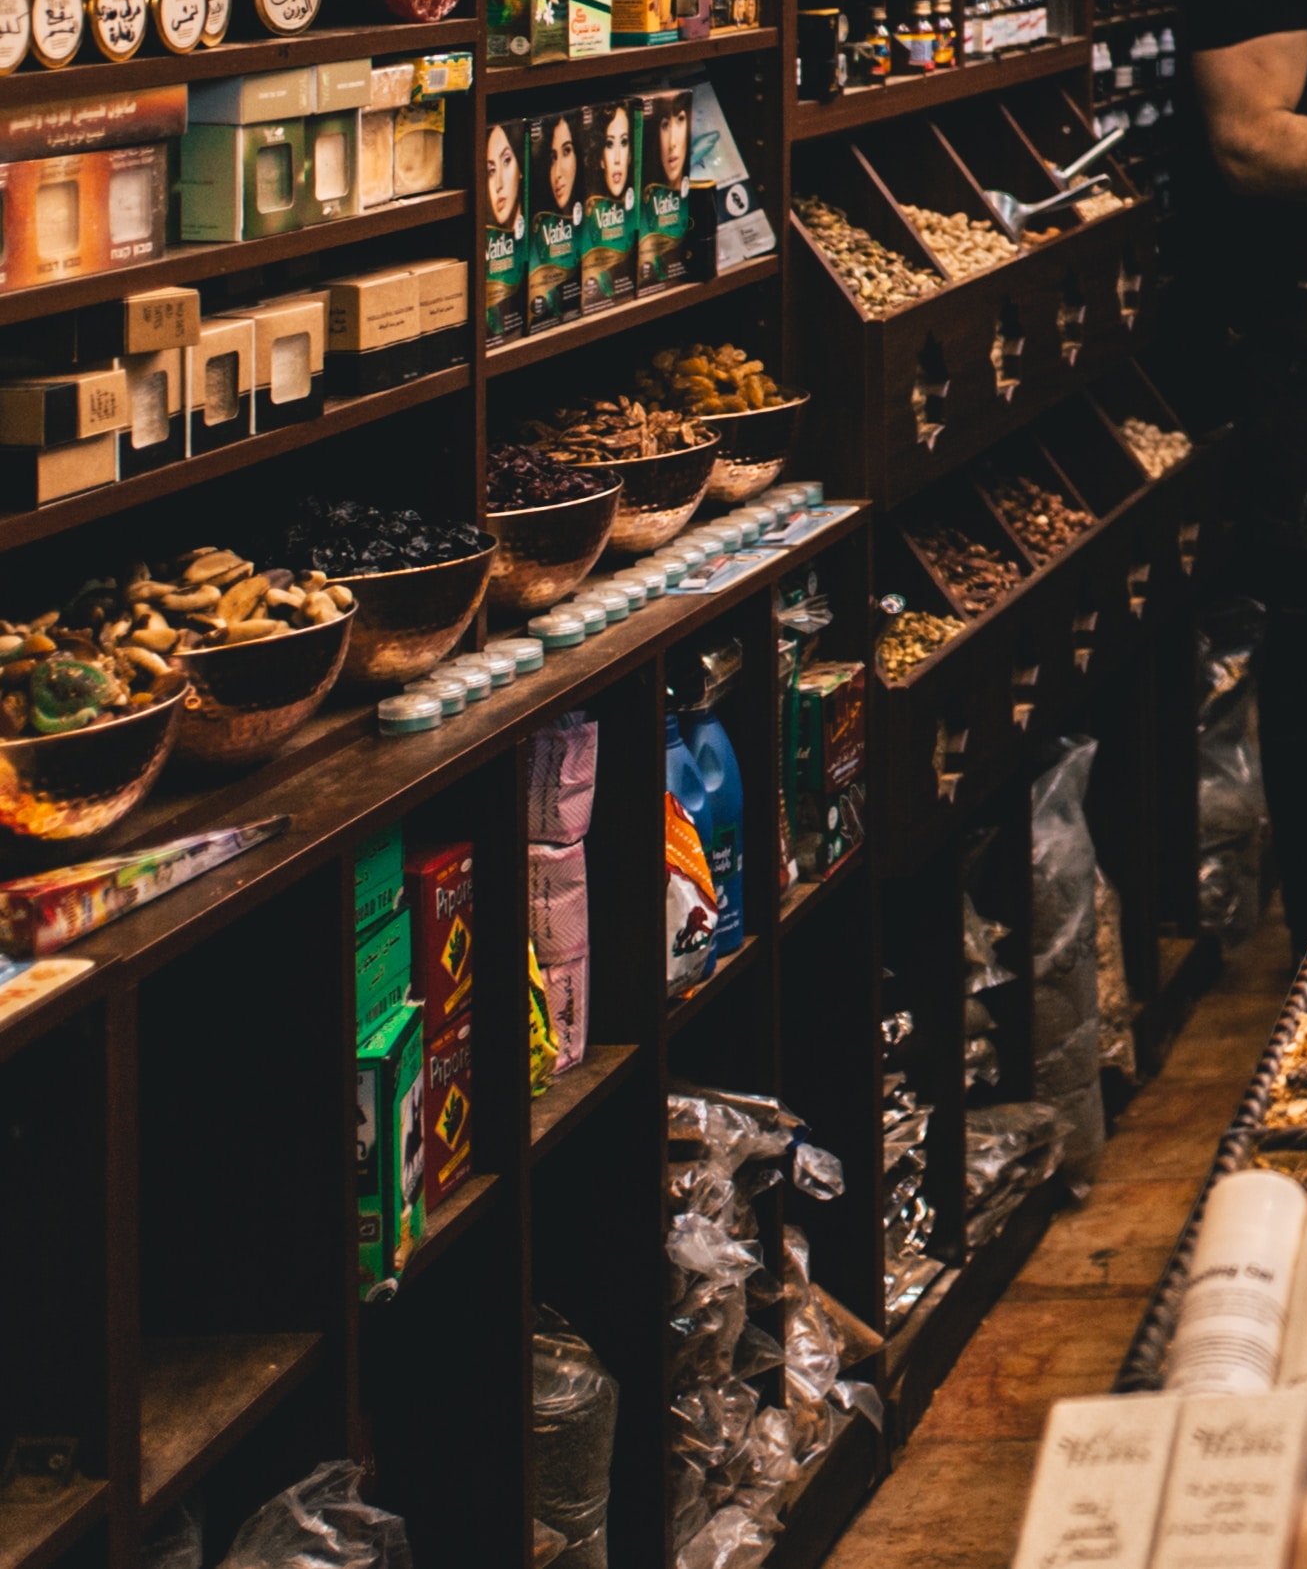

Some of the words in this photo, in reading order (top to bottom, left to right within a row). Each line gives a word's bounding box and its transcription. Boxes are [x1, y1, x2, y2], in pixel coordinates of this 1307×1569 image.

[595, 204, 624, 229] Vatika
[653, 192, 680, 216] Vatika
[543, 219, 572, 246] Vatika
